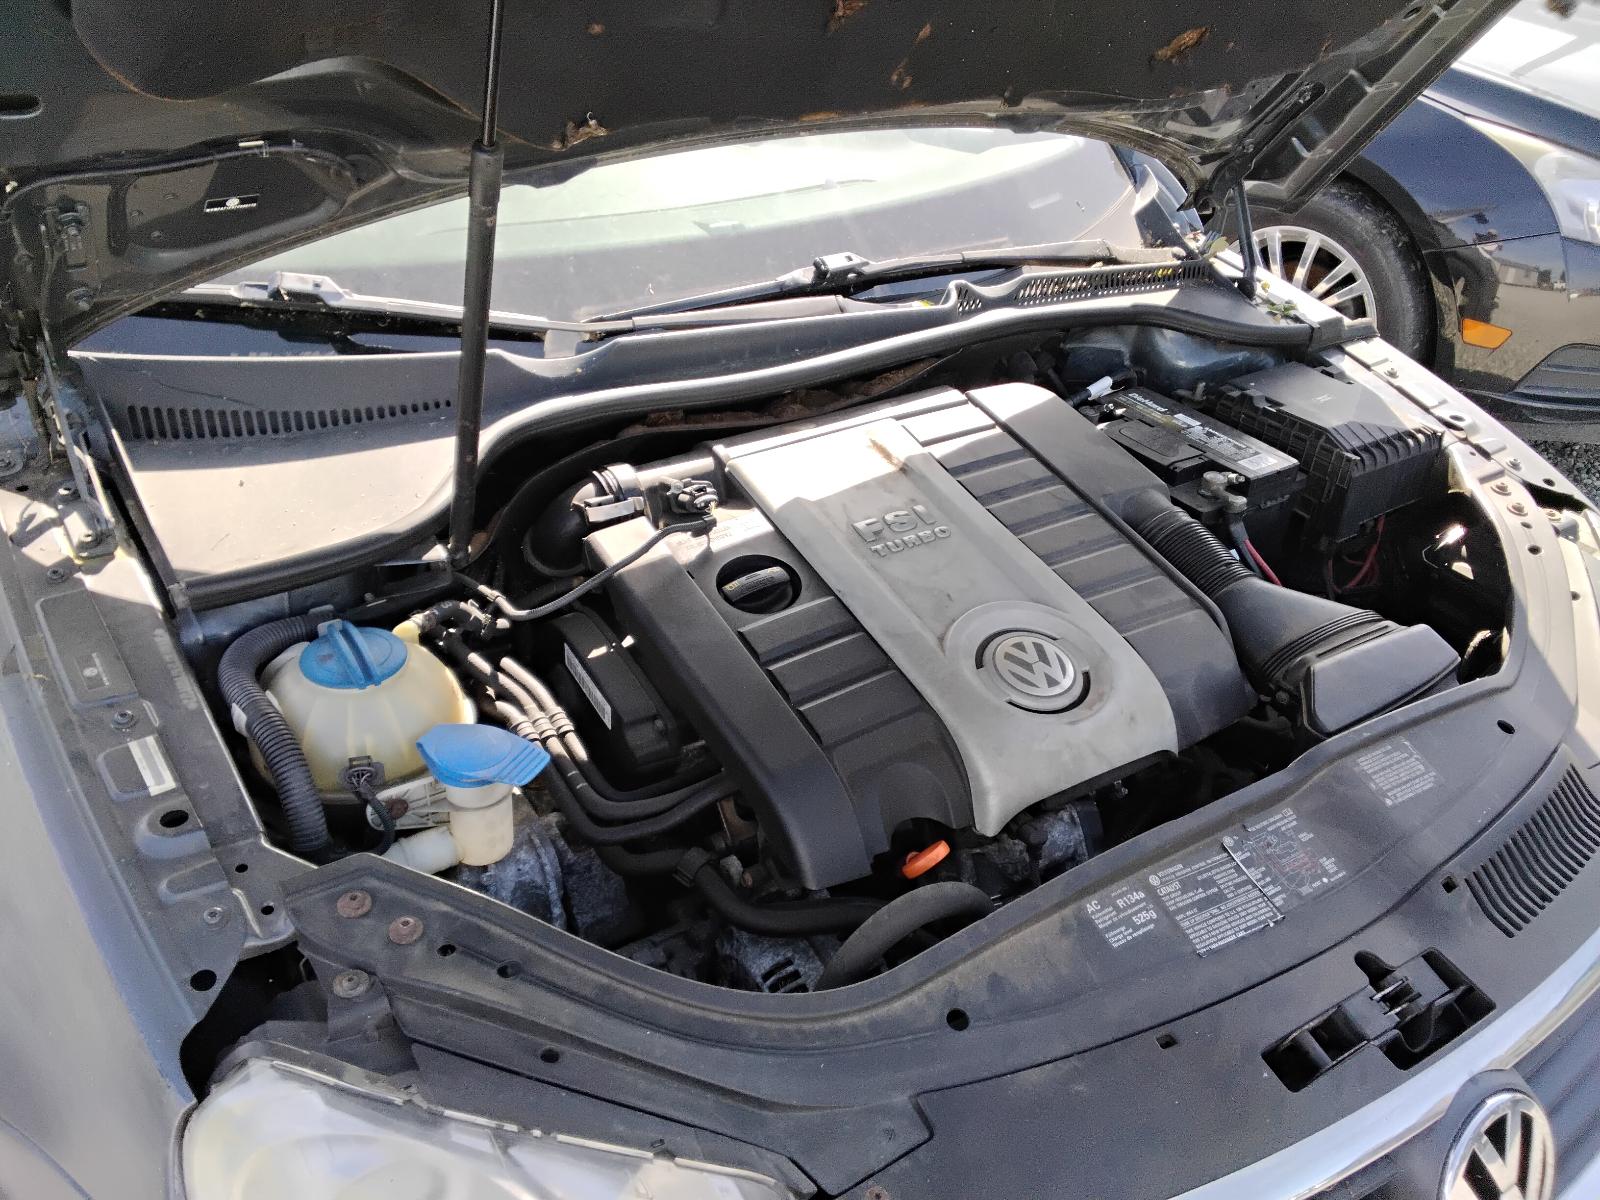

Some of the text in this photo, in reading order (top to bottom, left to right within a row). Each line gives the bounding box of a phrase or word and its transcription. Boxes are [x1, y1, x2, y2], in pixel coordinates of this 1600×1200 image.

[851, 504, 937, 543] FSI
[869, 526, 952, 557] TURBO
[1086, 900, 1101, 914] AC
[1116, 891, 1146, 909] R134a
[1132, 909, 1157, 926] 525g
